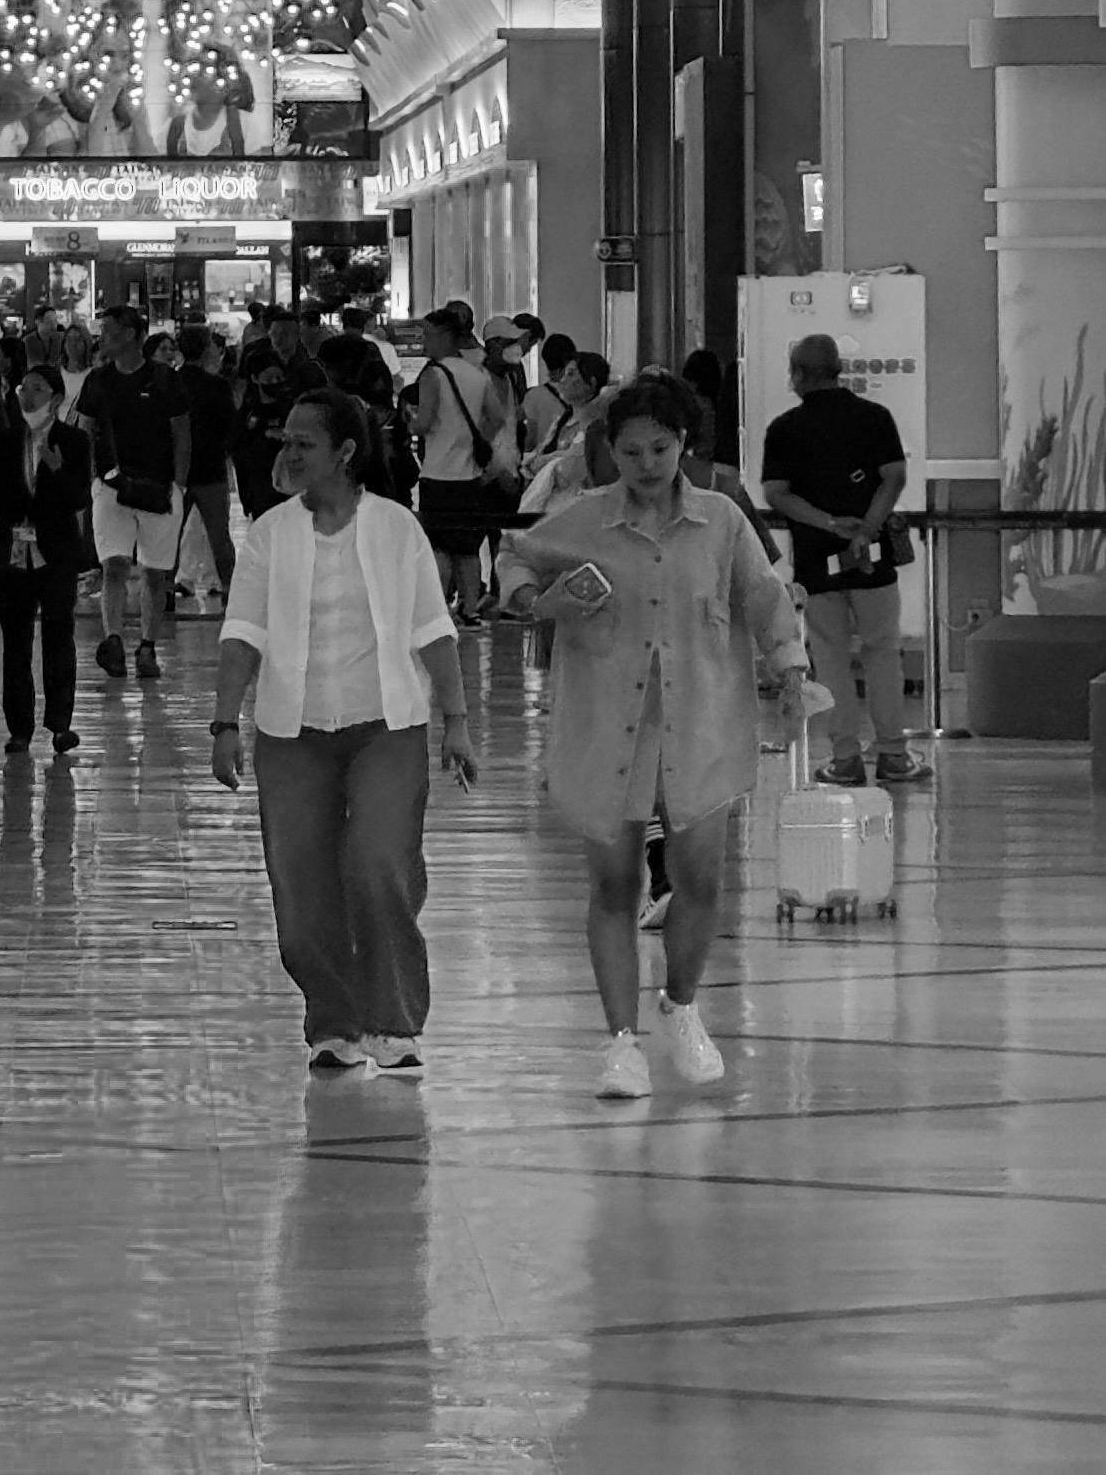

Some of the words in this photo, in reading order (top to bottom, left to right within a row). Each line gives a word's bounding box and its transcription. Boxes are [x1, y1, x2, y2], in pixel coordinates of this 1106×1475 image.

[9, 177, 136, 200] TOBACCO
[158, 177, 258, 200] LIQUOR
[66, 230, 81, 251] 8
